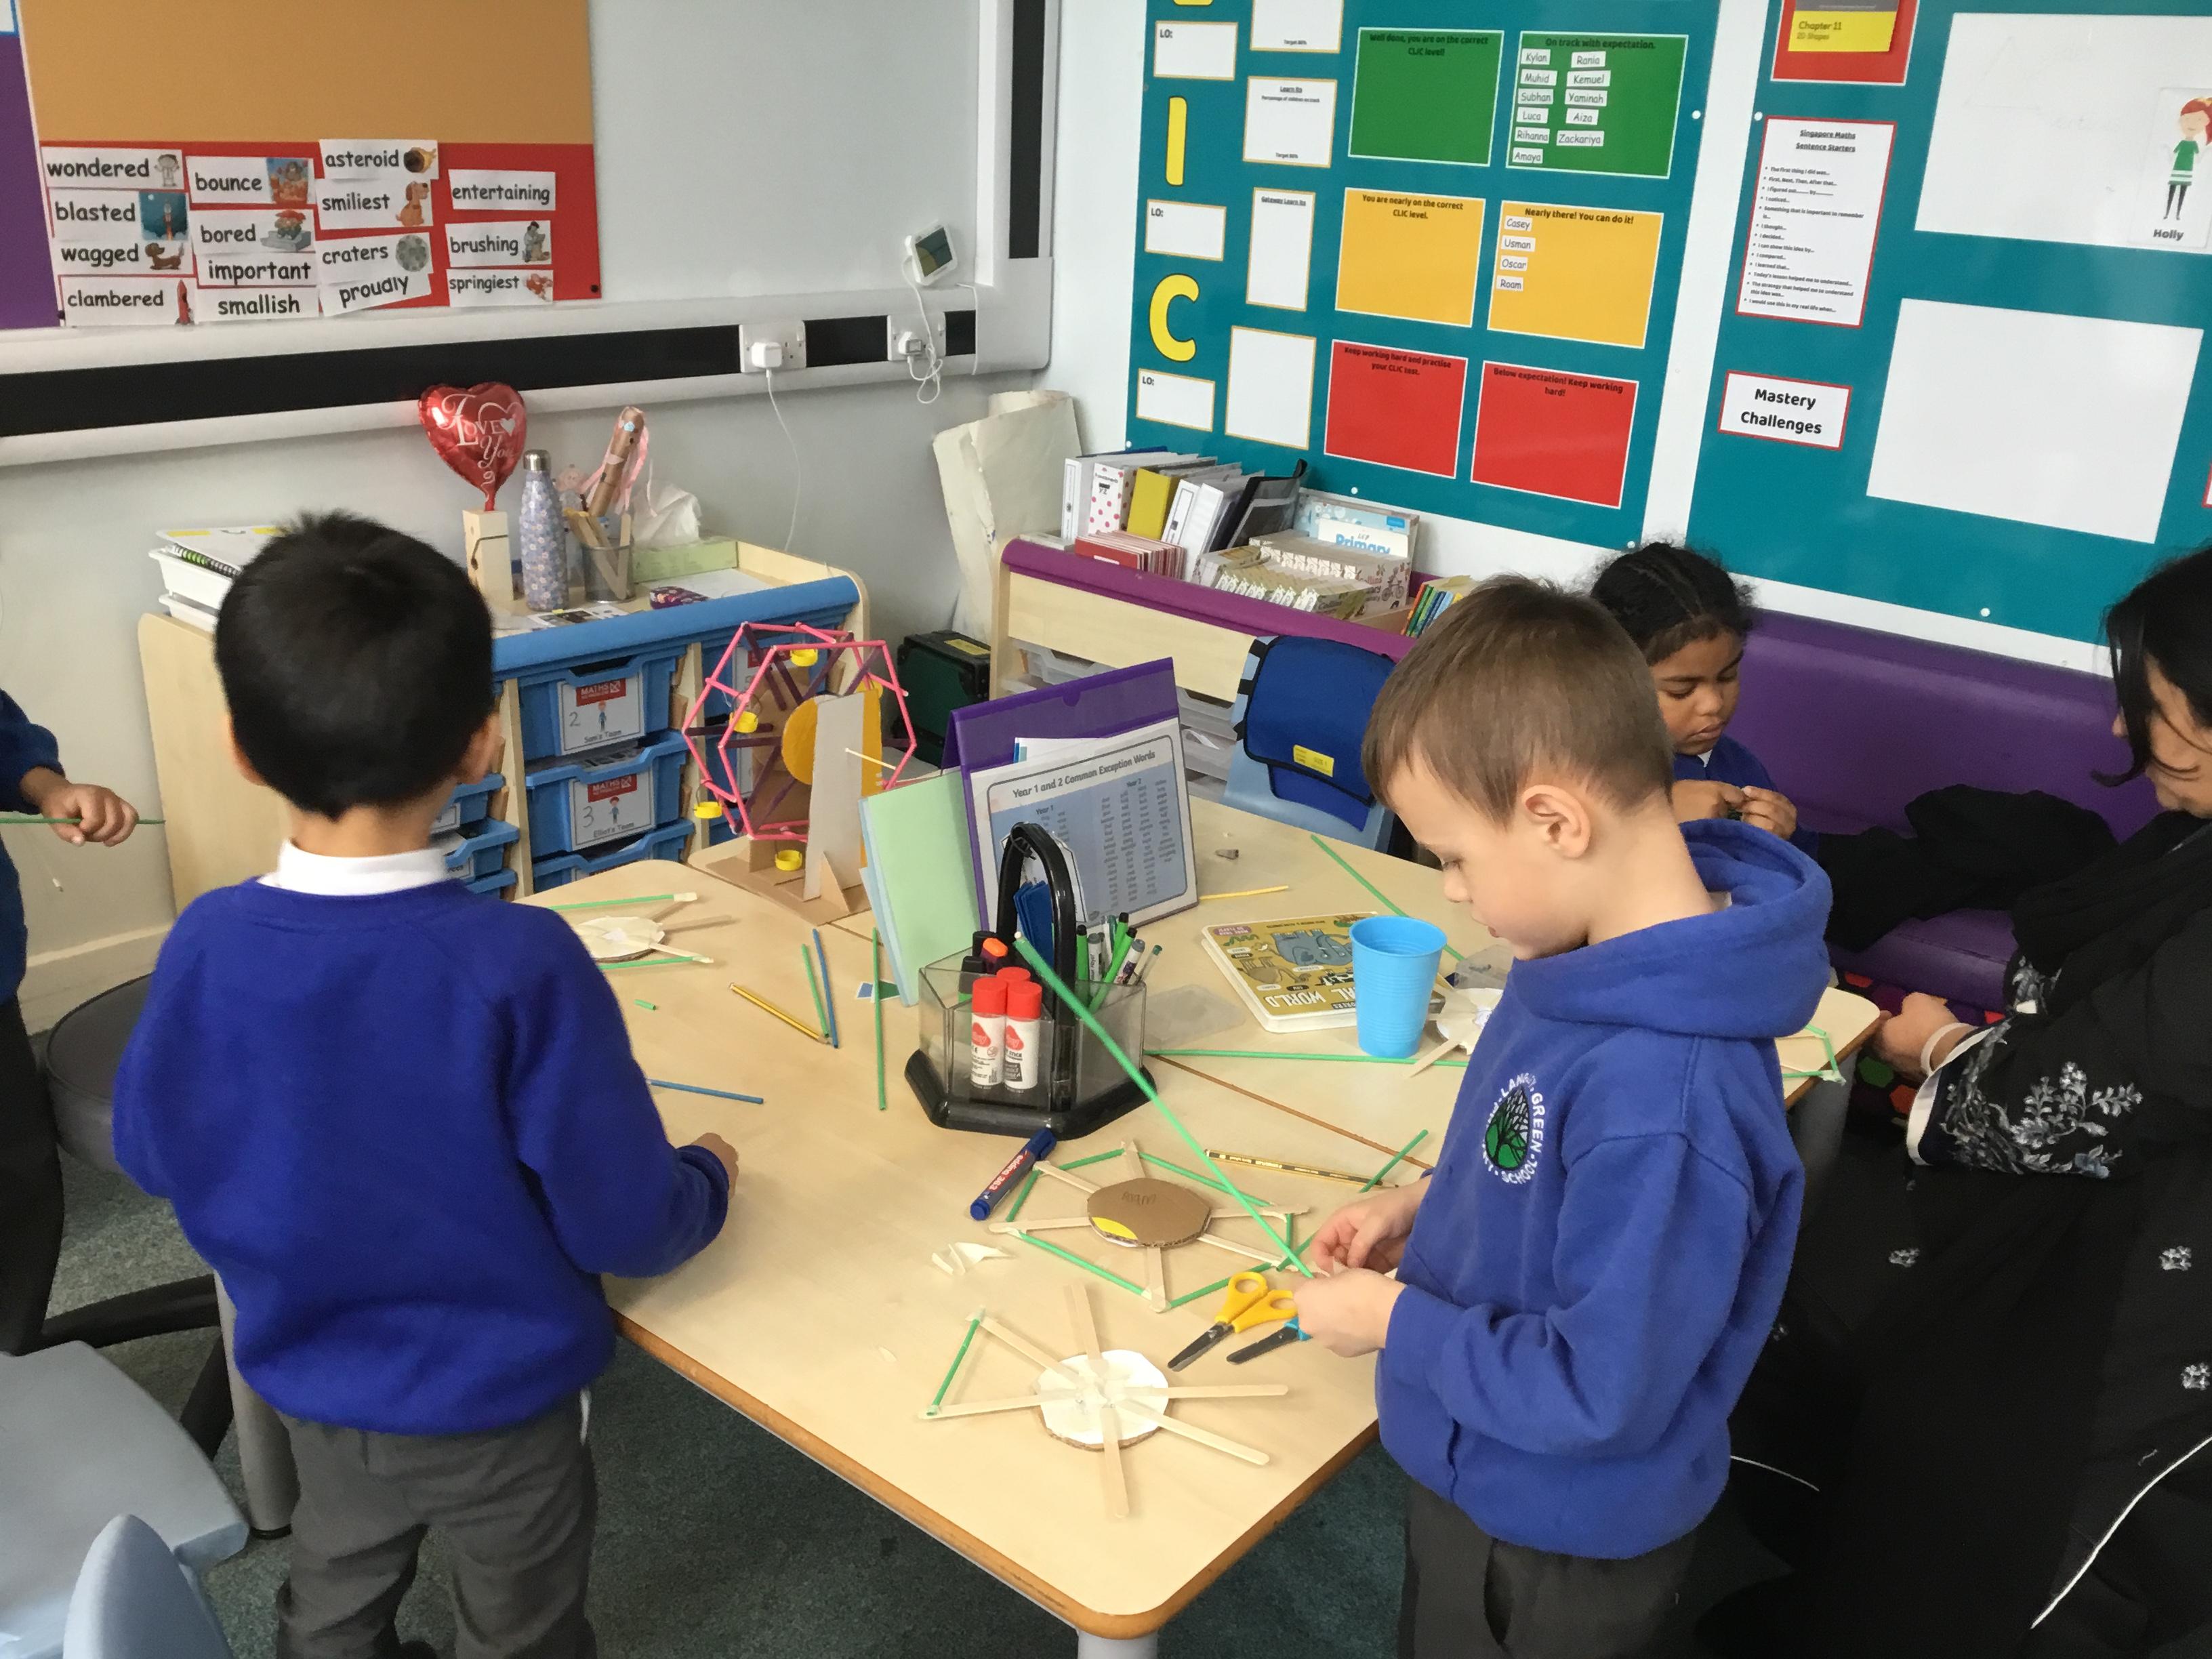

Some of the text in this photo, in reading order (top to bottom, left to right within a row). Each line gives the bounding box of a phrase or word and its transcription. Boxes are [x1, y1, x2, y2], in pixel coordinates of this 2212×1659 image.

[1799, 21, 1842, 30] Chapter 11
[1160, 29, 1173, 38] LO:
[1408, 35, 1421, 43] you
[1460, 37, 1488, 45] correct
[1545, 38, 1656, 49] On track with expectation.
[1525, 52, 1547, 64] Kylan
[1577, 56, 1600, 64] Rania
[1524, 73, 1549, 83] Muhid
[1574, 75, 1604, 84] Kemuel
[1521, 92, 1551, 102] Subhan
[1569, 94, 1603, 103] Yaminah
[1522, 111, 1541, 120] Luca
[1573, 113, 1593, 123] Aiza
[1517, 130, 1548, 141] Rihanna
[1559, 134, 1601, 146] Zackariya
[1800, 129, 1856, 140] Singapore Maths
[1796, 142, 1856, 152] Sentence Starters
[325, 149, 399, 167] asteroid
[1514, 152, 1541, 163] Amaya
[47, 157, 150, 177] wondered
[195, 172, 262, 190] bounce
[452, 184, 550, 205] entertaining
[322, 192, 390, 211] smiliest
[1389, 197, 1412, 207] nearly
[1423, 199, 1435, 207] the
[1437, 202, 1463, 210] correct
[55, 201, 136, 221] blasted
[1151, 208, 1163, 217] LO:
[1393, 209, 1429, 219] CLIC level.
[1525, 208, 1551, 218] Nearly
[1552, 211, 1577, 220] there!
[1579, 212, 1594, 221] You
[1612, 215, 1623, 224] do
[1624, 216, 1634, 224] it!
[1507, 218, 1531, 230] Casey
[201, 223, 256, 243] bored
[2153, 229, 2184, 241] Holly
[450, 234, 518, 256] brushing
[1504, 238, 1531, 249] Usman
[61, 243, 140, 267] wagged
[322, 245, 389, 264] craters
[1502, 258, 1526, 269] Oscar
[208, 260, 311, 286] important
[449, 274, 520, 293] springiest
[1500, 279, 1521, 289] Roam
[68, 289, 164, 307] clambered
[339, 276, 409, 308] proudly
[218, 293, 300, 315] smallish
[1149, 273, 1200, 362] C
[1345, 347, 1361, 356] Keep
[1362, 350, 1389, 361] working
[1391, 354, 1407, 362] hard
[1372, 363, 1387, 371] your
[1389, 364, 1403, 372] CLIC
[1142, 376, 1154, 386] LO:
[1494, 367, 1623, 394] Below expectation! Keep working
[1755, 388, 1816, 410] Mastery
[1741, 411, 1822, 434] Challenges
[1336, 533, 1391, 554] Primary
[581, 684, 609, 695] MATHS
[569, 712, 581, 726] 2
[1012, 750, 1155, 798] Year 1 and 2 Common Exception Words
[593, 779, 621, 792] MATHS
[583, 806, 594, 827] 3
[1036, 806, 1049, 815] Year
[1265, 991, 1326, 1008] WORLD
[1531, 1092, 1546, 1153] GREEN
[1001, 1155, 1023, 1175] edding
